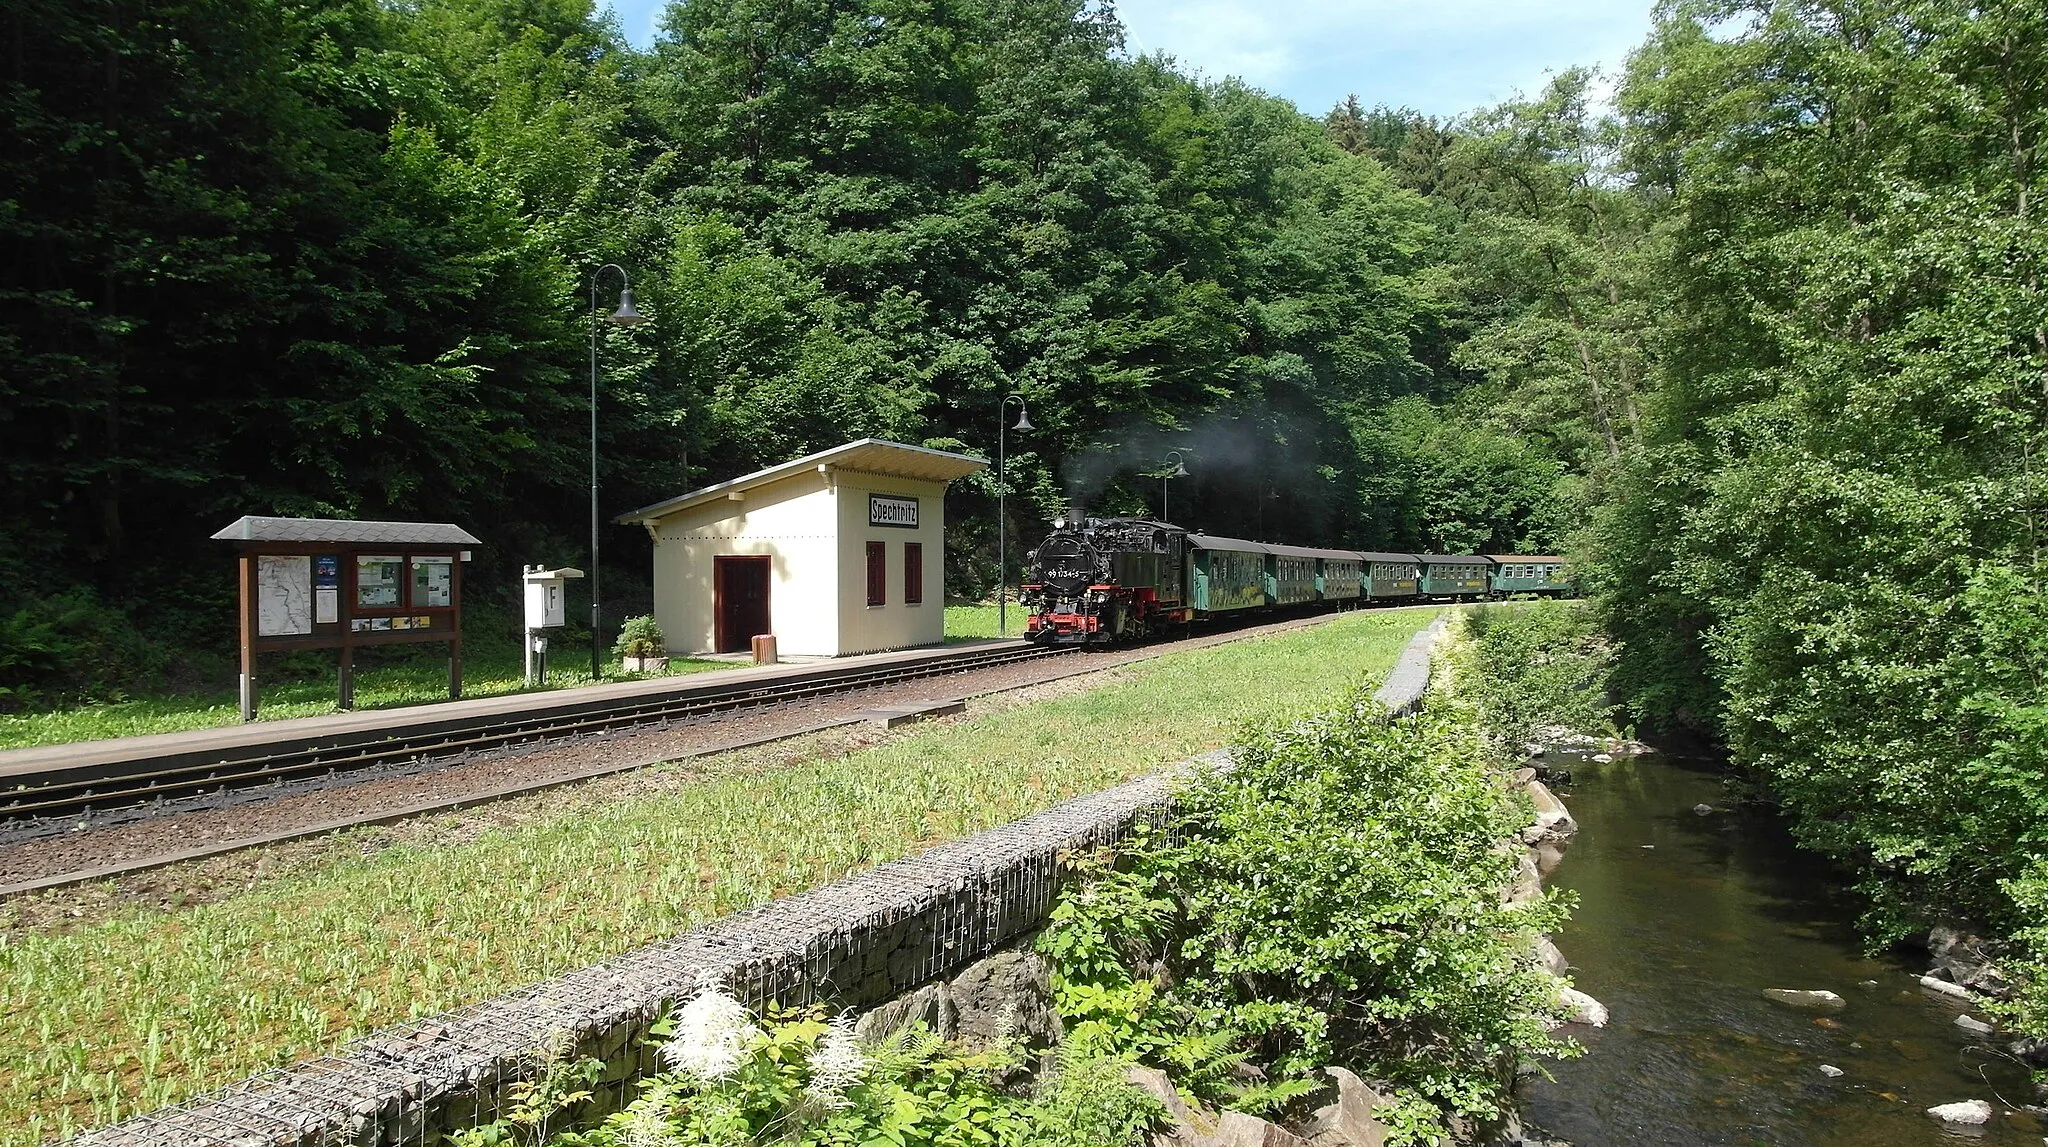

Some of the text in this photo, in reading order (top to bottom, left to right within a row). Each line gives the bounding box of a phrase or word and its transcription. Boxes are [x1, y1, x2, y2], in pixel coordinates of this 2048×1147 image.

[872, 499, 916, 522] Spechtritz
[1048, 570, 1057, 578] 99
[550, 586, 557, 609] F
